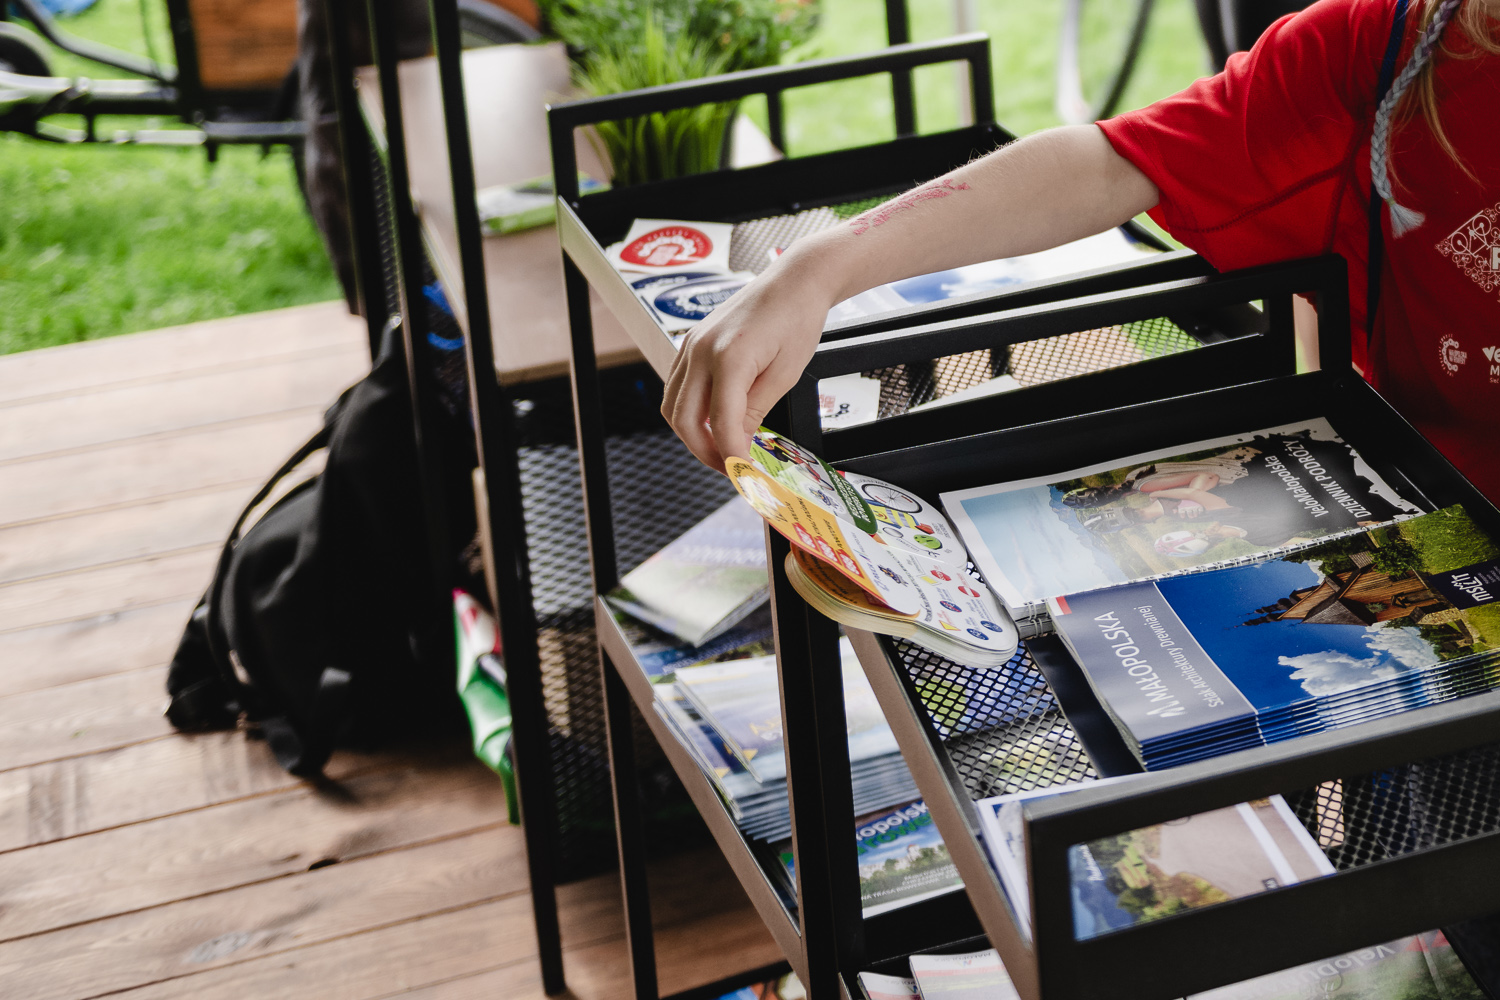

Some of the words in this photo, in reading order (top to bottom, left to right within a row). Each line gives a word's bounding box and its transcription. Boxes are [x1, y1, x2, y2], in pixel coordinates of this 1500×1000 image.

[1283, 440, 1333, 479] PODRÓŻY
[1322, 480, 1372, 518] DZIENNIK
[1136, 604, 1176, 647] Drewnianej
[1093, 610, 1174, 701] MAŁOPOLSKA
[1167, 648, 1207, 688] Architektury
[1196, 684, 1223, 707] Szlak
